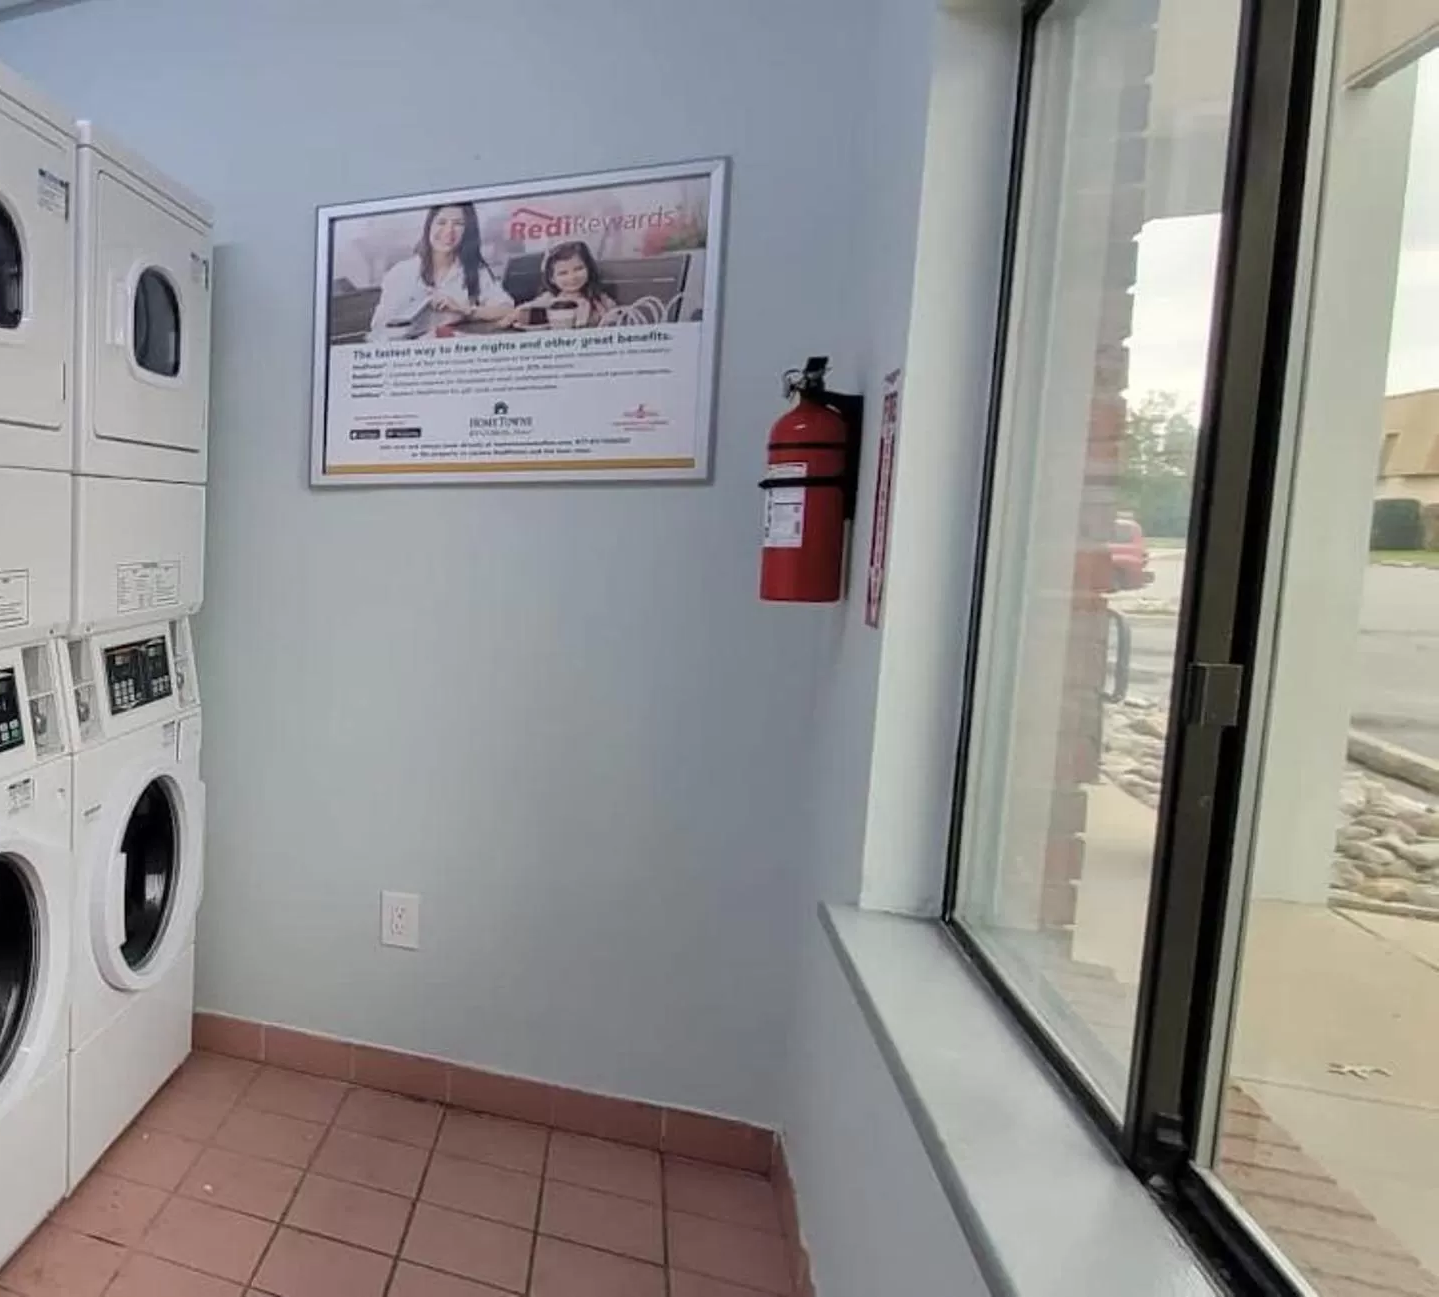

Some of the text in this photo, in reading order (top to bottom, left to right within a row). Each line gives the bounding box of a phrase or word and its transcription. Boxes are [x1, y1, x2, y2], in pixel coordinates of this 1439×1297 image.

[353, 351, 372, 359] The
[415, 347, 436, 357] way
[440, 346, 452, 354] to
[520, 339, 541, 349] and
[545, 338, 577, 348] other
